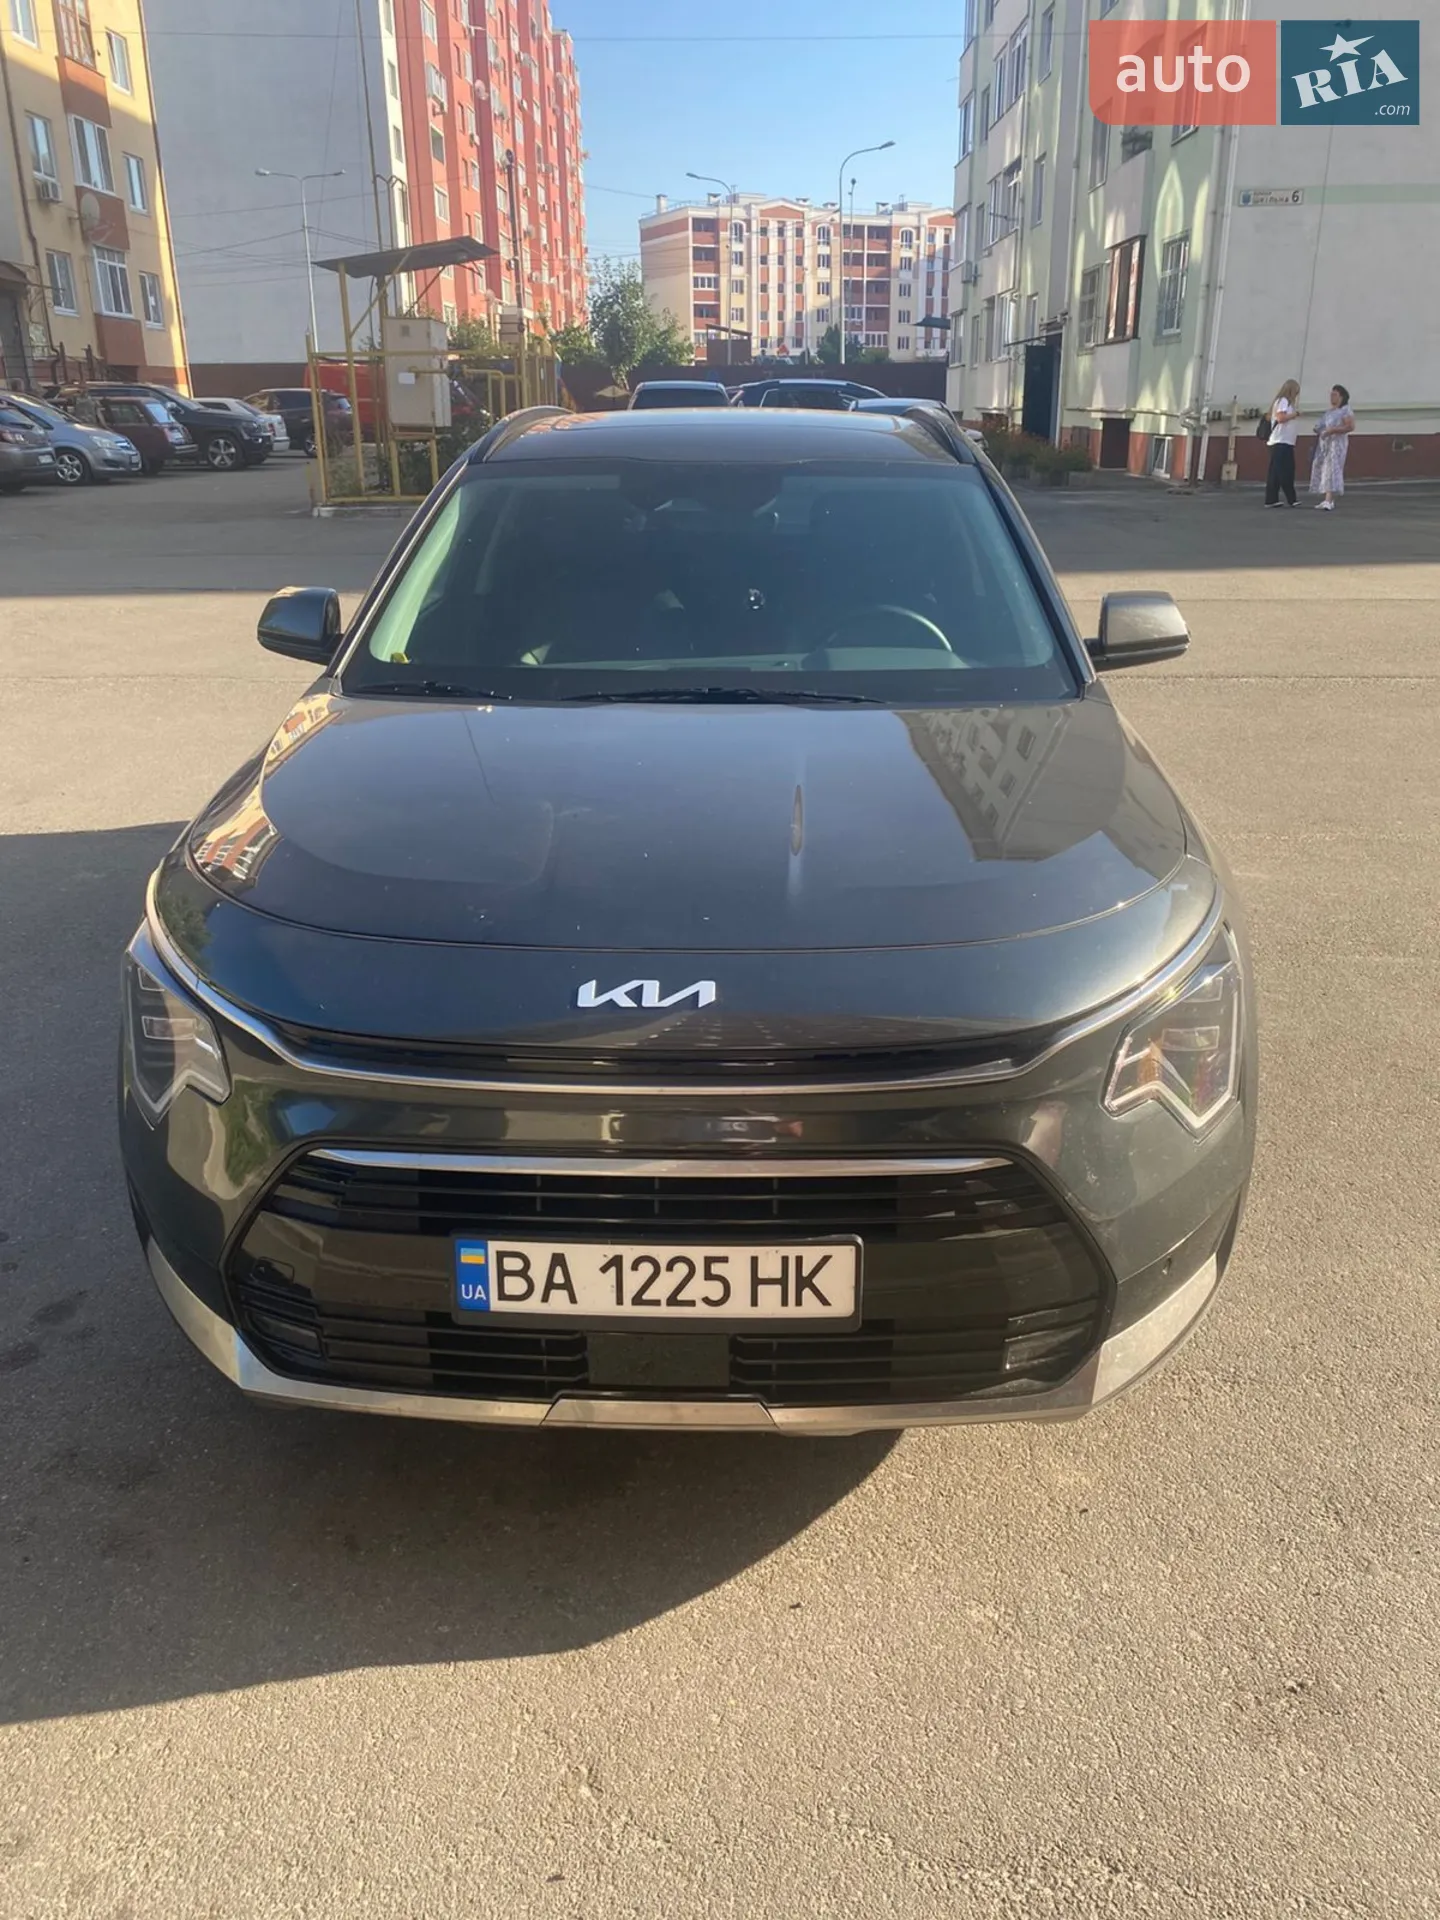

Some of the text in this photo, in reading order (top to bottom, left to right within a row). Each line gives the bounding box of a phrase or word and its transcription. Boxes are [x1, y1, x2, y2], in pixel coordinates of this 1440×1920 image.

[1291, 190, 1299, 203] 6
[577, 979, 716, 1008] KIA
[495, 1250, 832, 1308] BA 1225 HK
[461, 1283, 486, 1300] UA
